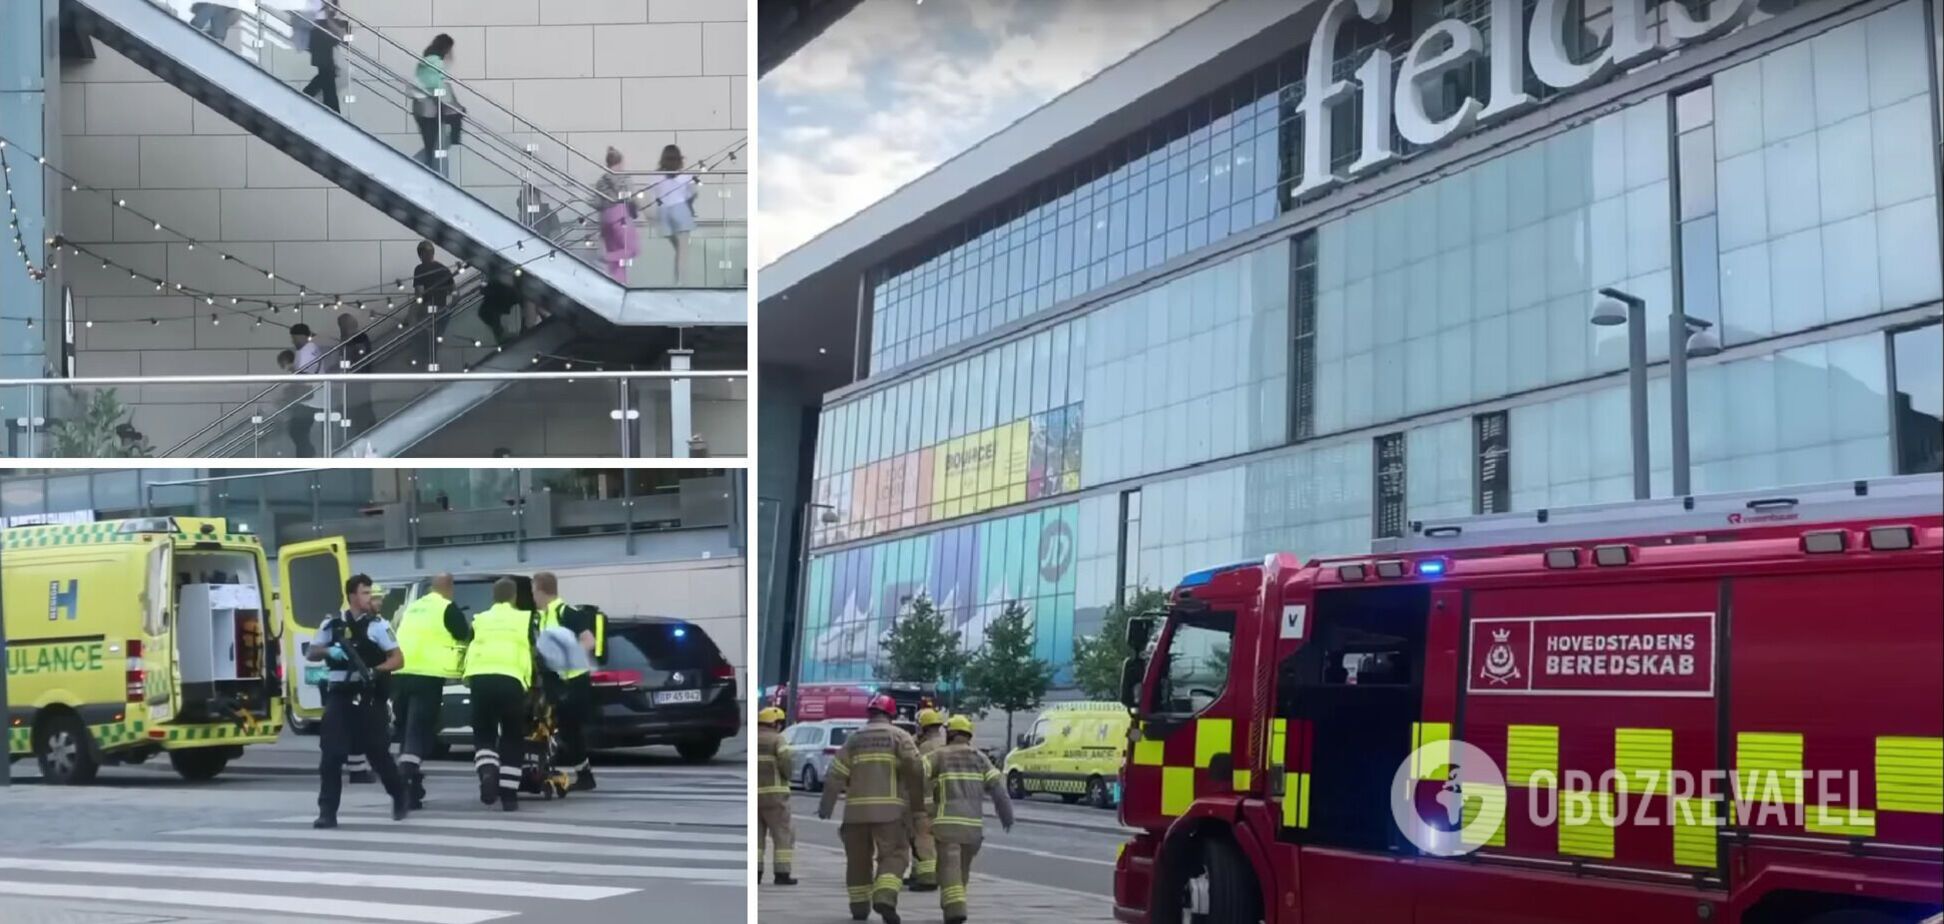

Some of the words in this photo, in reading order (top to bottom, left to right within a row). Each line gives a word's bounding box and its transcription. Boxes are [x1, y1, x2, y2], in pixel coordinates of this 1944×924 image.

[1288, 613, 1298, 627] V
[1547, 634, 1695, 651] HOVEDSTADENS
[1546, 654, 1695, 675] BEREDSKAB
